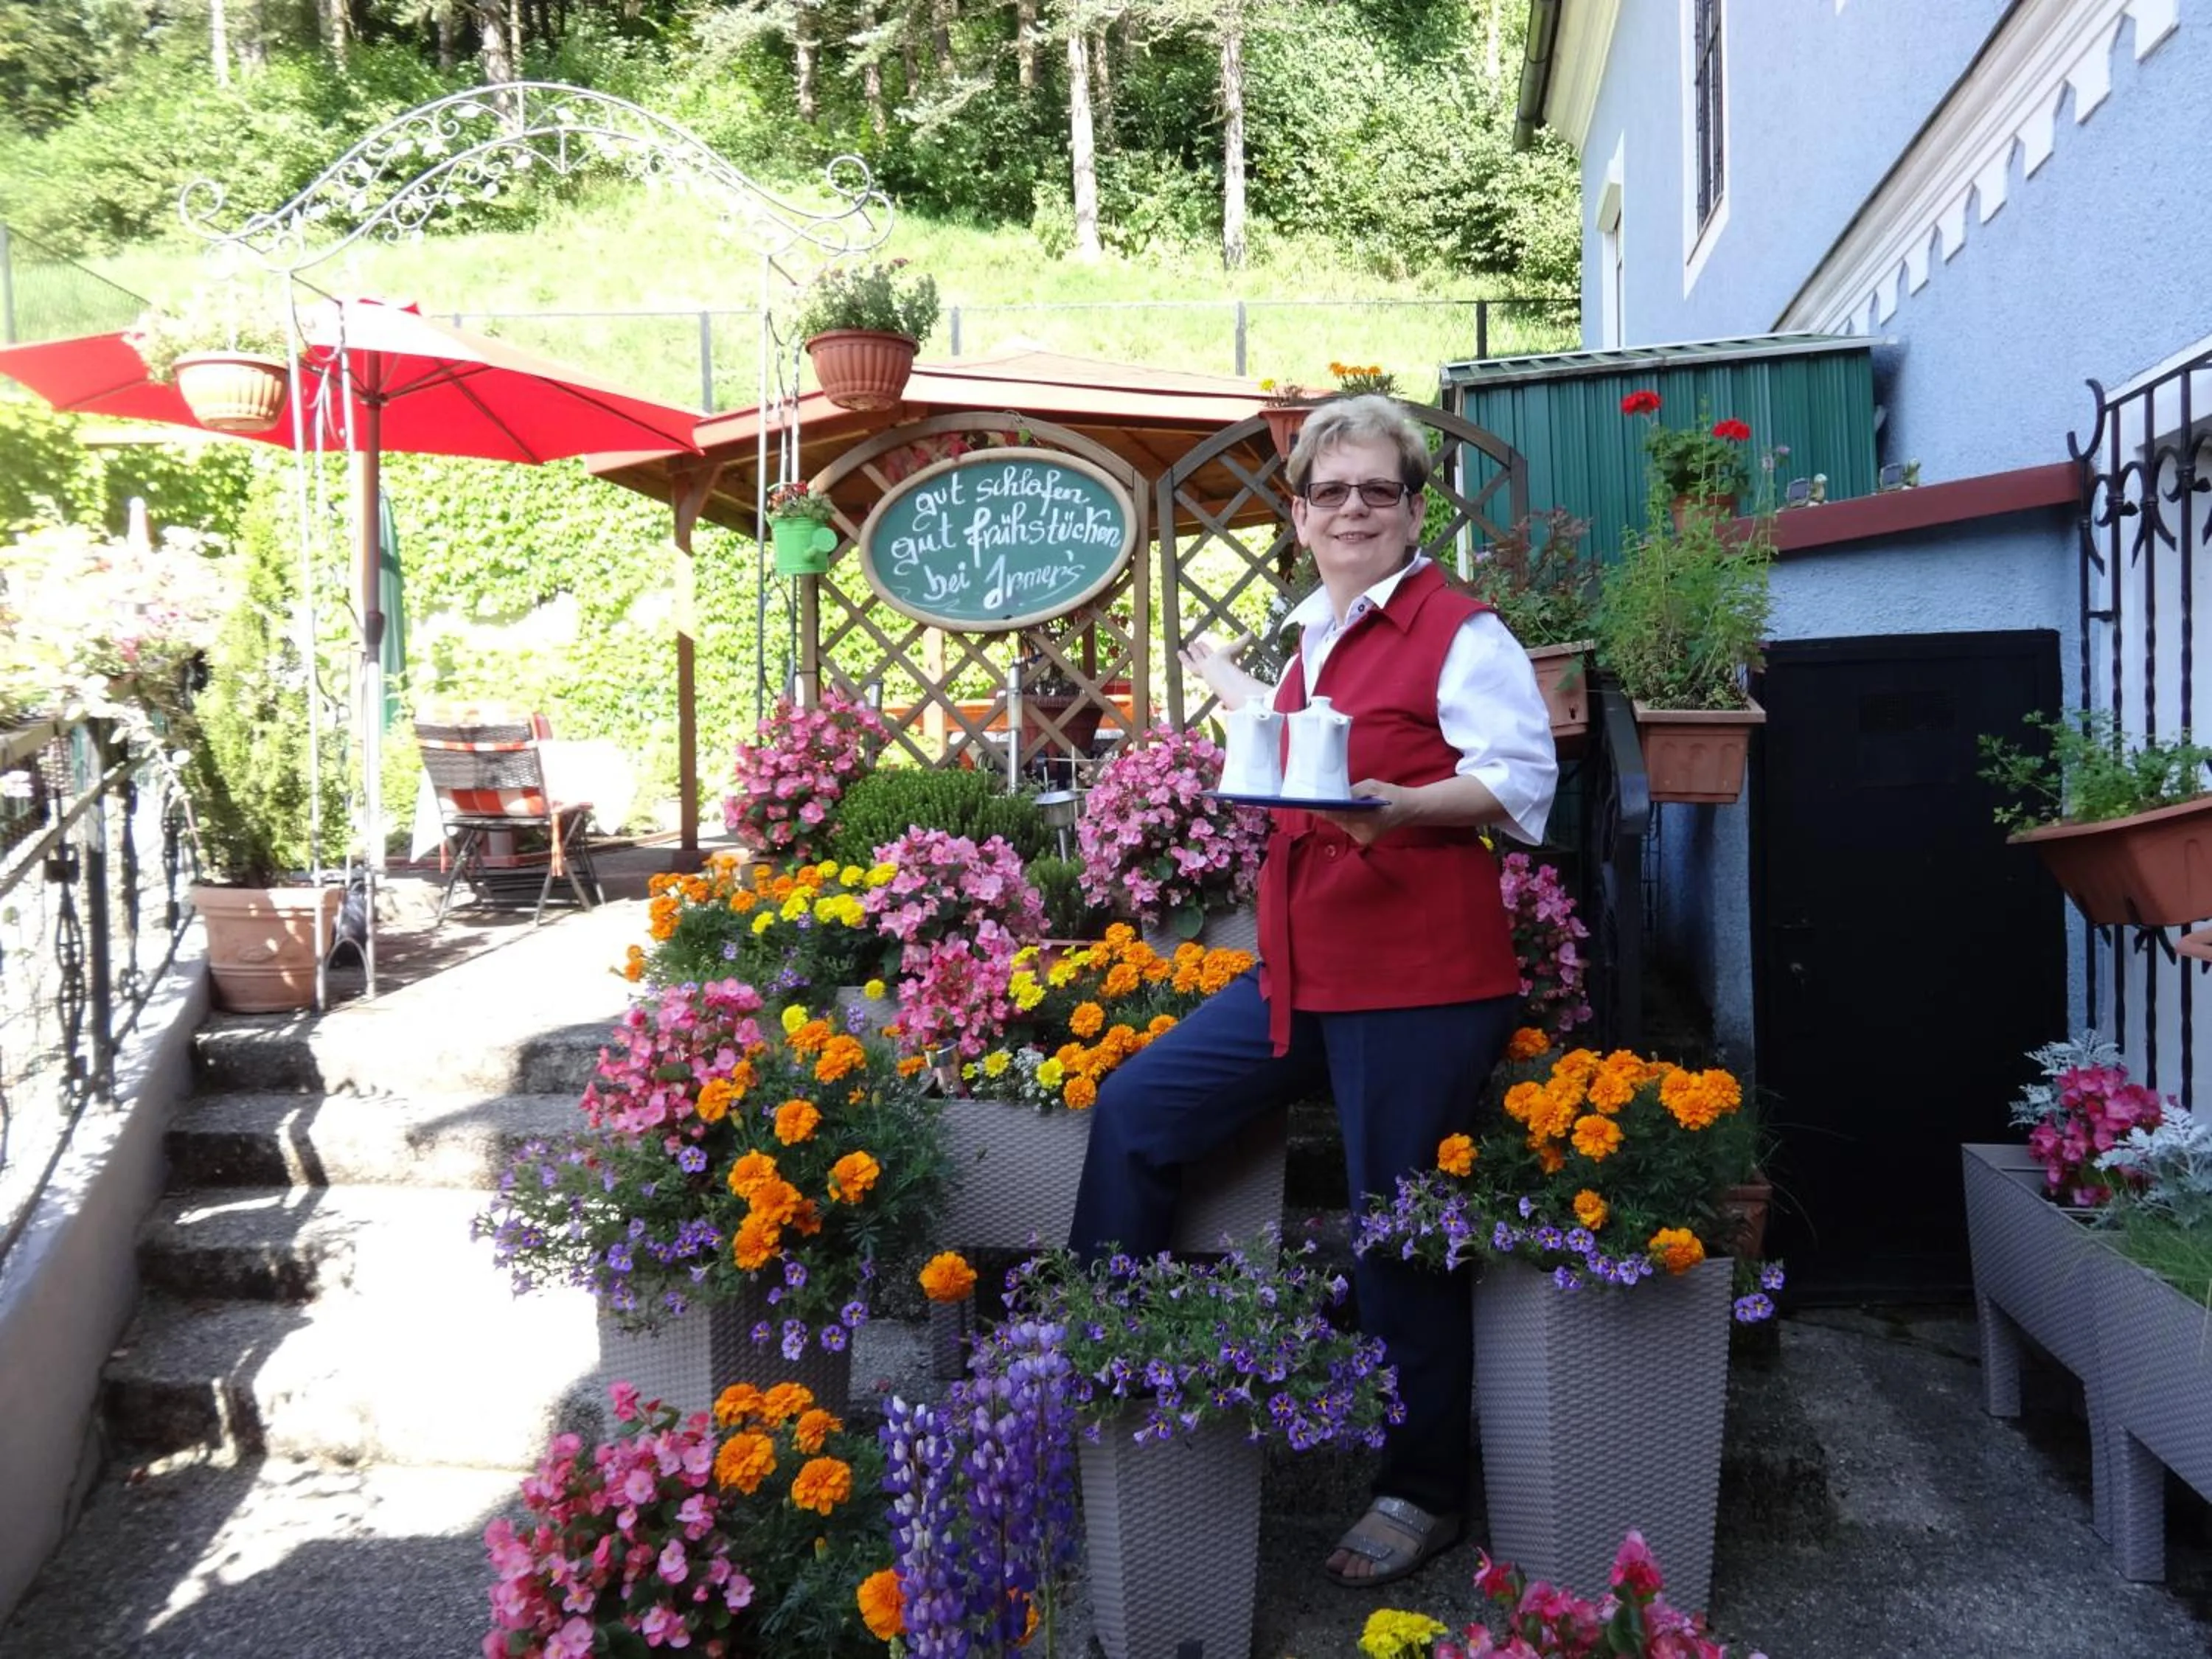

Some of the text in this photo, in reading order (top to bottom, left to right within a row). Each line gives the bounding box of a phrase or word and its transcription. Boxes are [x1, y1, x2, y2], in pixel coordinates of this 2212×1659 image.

[912, 472, 965, 532] gut
[891, 511, 956, 576] gut
[922, 560, 971, 600] bei
